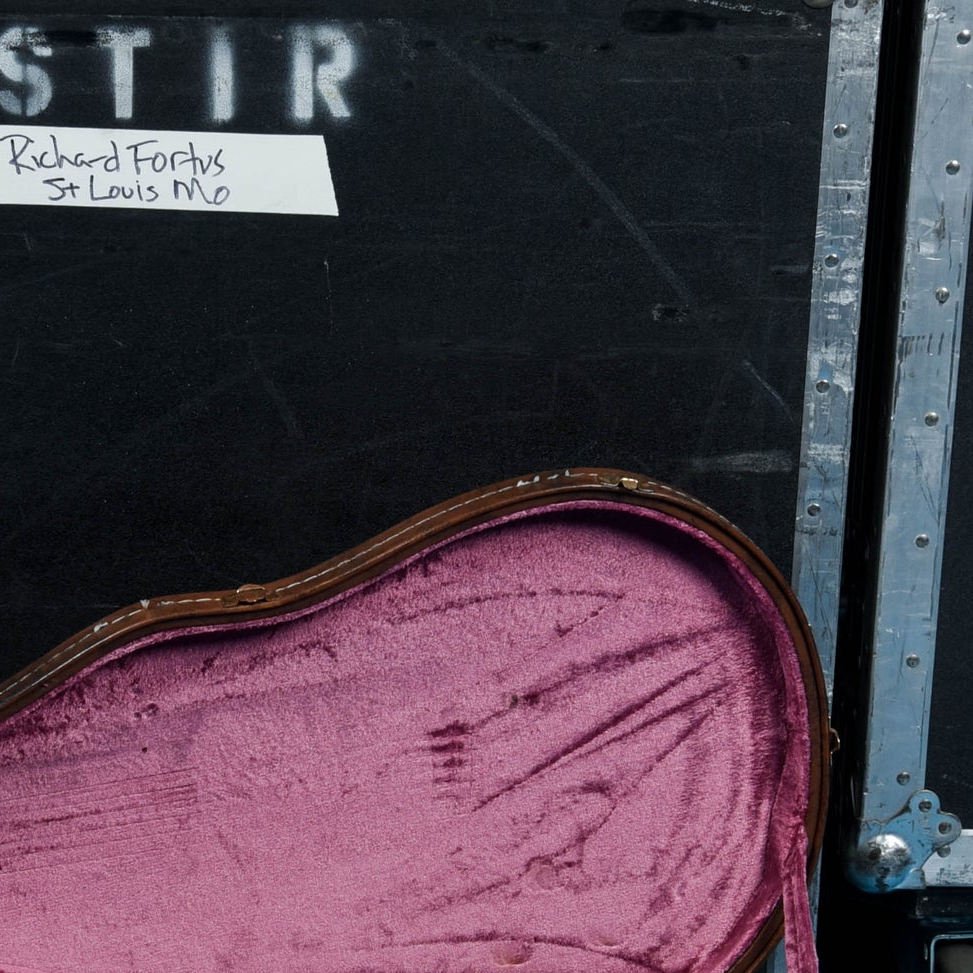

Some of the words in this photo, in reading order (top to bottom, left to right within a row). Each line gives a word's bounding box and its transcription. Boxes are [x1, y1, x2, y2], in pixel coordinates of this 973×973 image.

[0, 134, 120, 175] Richard
[43, 178, 80, 201] St
[89, 174, 159, 202] Louis
